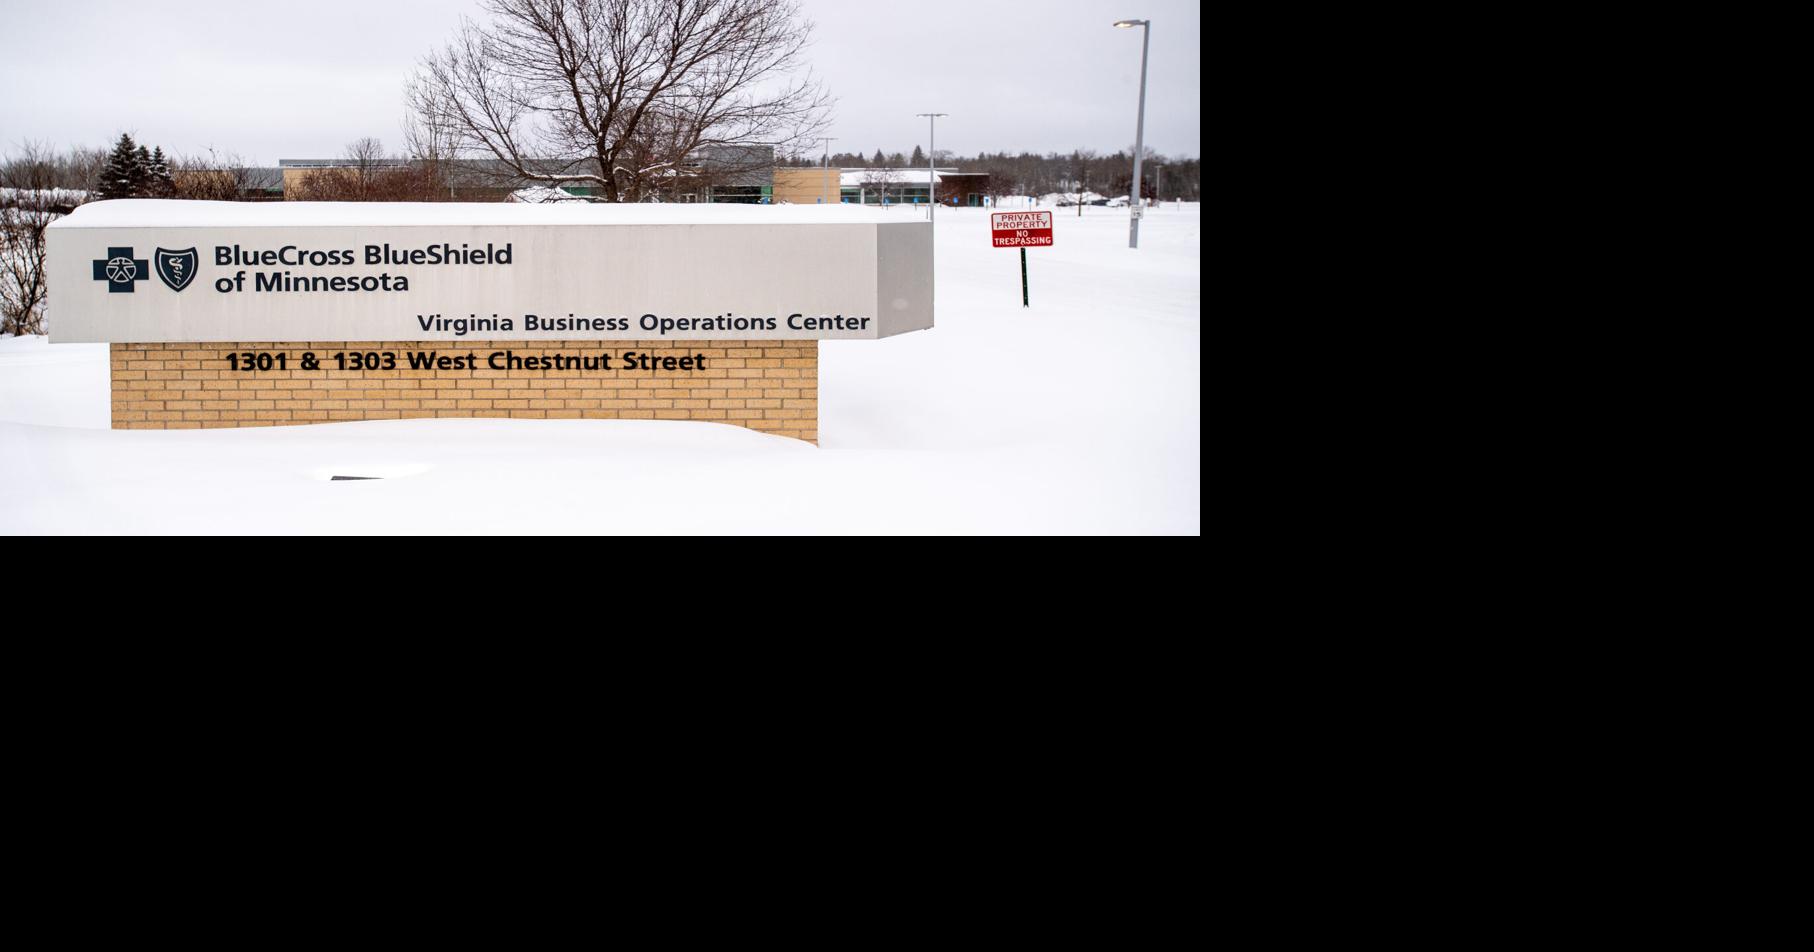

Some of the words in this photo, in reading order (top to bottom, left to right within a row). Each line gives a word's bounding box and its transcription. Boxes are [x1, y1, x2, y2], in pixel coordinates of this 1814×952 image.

[996, 220, 1047, 228] PROPERTY
[1001, 213, 1042, 221] PRIVATE
[994, 236, 1051, 245] TRESPASSING
[214, 244, 355, 267] BlueCross
[364, 242, 513, 266] BlueShield
[214, 270, 246, 294] of
[255, 270, 410, 293] Minnesota
[417, 313, 514, 337] Virginia
[524, 313, 629, 331] Business
[639, 312, 777, 336] Operations
[786, 313, 871, 331] Center
[225, 352, 287, 372] 1301
[300, 351, 321, 371] &
[334, 351, 397, 371] 1303
[406, 351, 478, 371] West
[487, 350, 612, 371] Chestnut
[622, 351, 706, 371] Street
